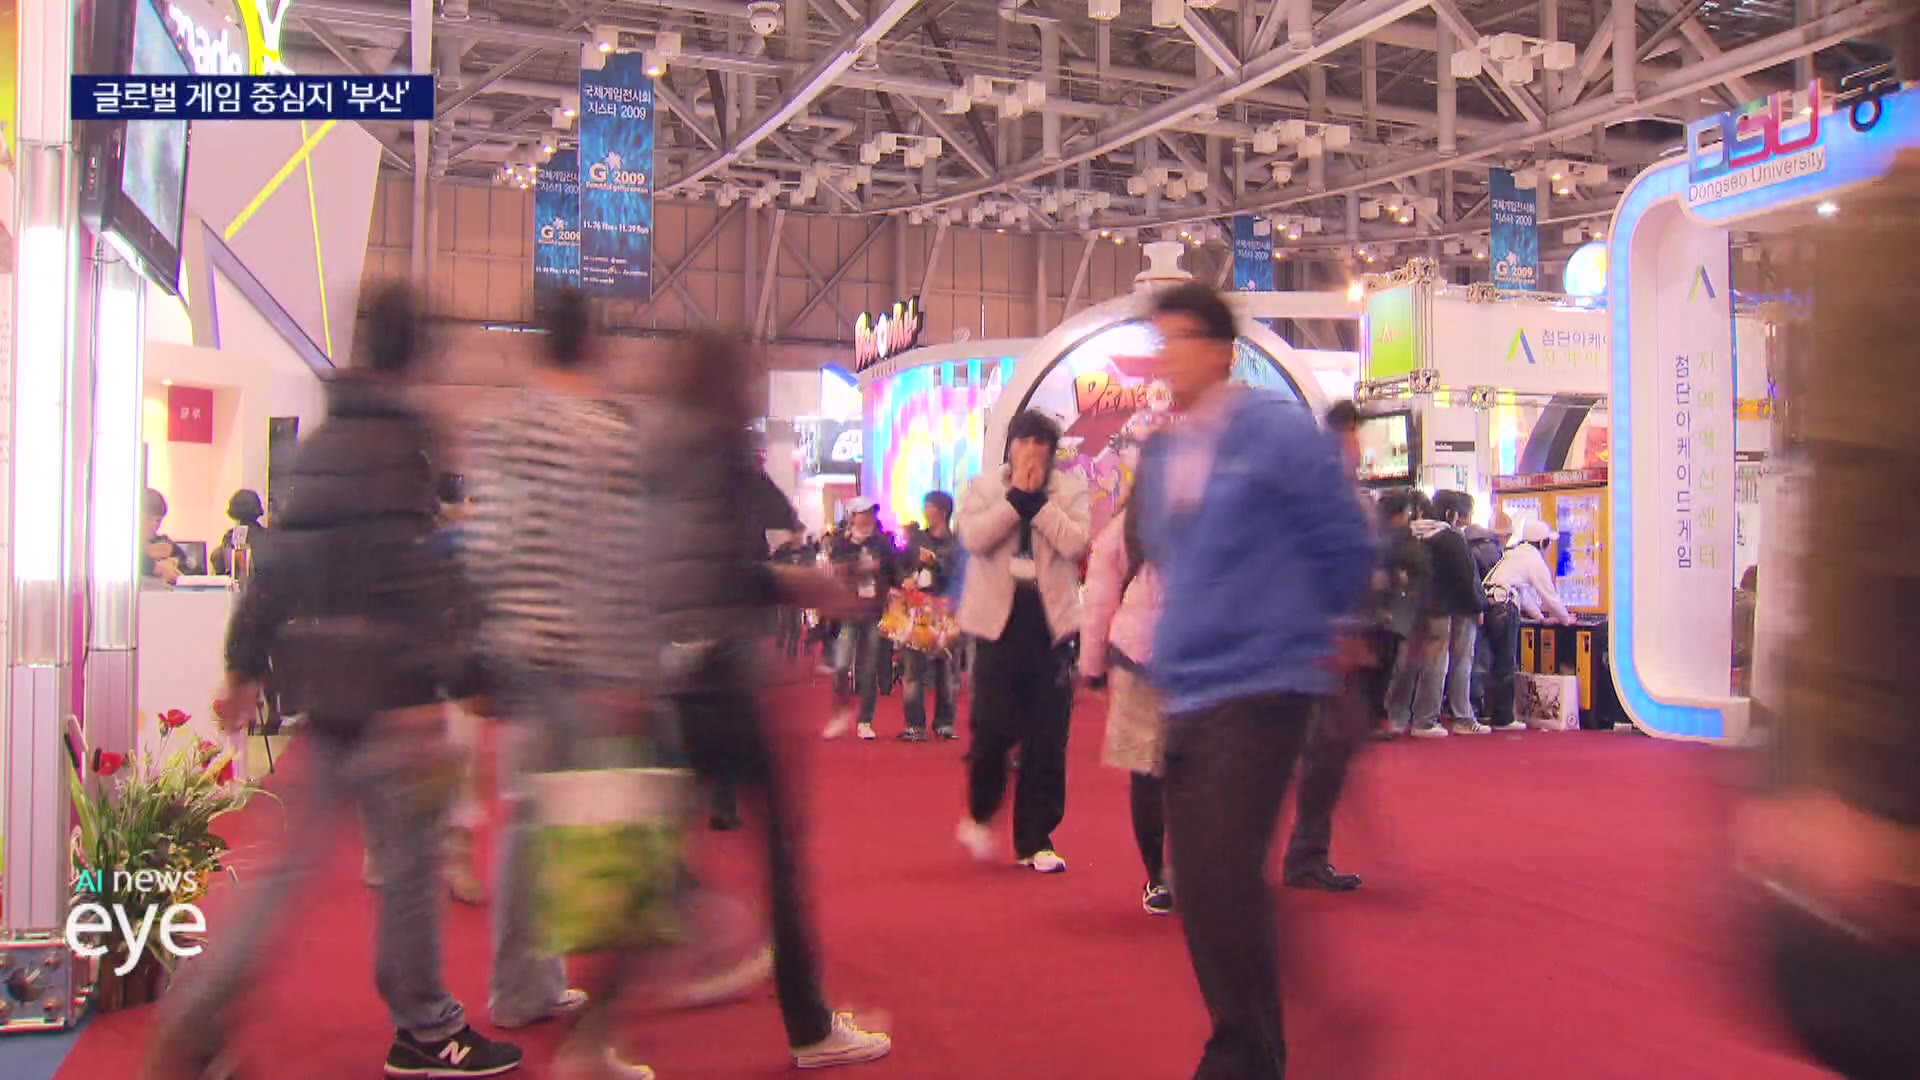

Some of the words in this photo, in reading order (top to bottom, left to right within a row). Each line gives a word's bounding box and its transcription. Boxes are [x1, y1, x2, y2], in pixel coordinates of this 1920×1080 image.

[584, 85, 652, 104] 국제게임전시회
[588, 102, 617, 117] 지스타
[620, 105, 647, 120] 2009
[1687, 78, 1822, 184] DSU
[613, 169, 646, 186] 2009
[1689, 173, 1749, 202] Dongseo
[1751, 150, 1824, 184] University
[1512, 264, 1534, 278] 2009
[1676, 354, 1692, 569] 첨단아케이드게임
